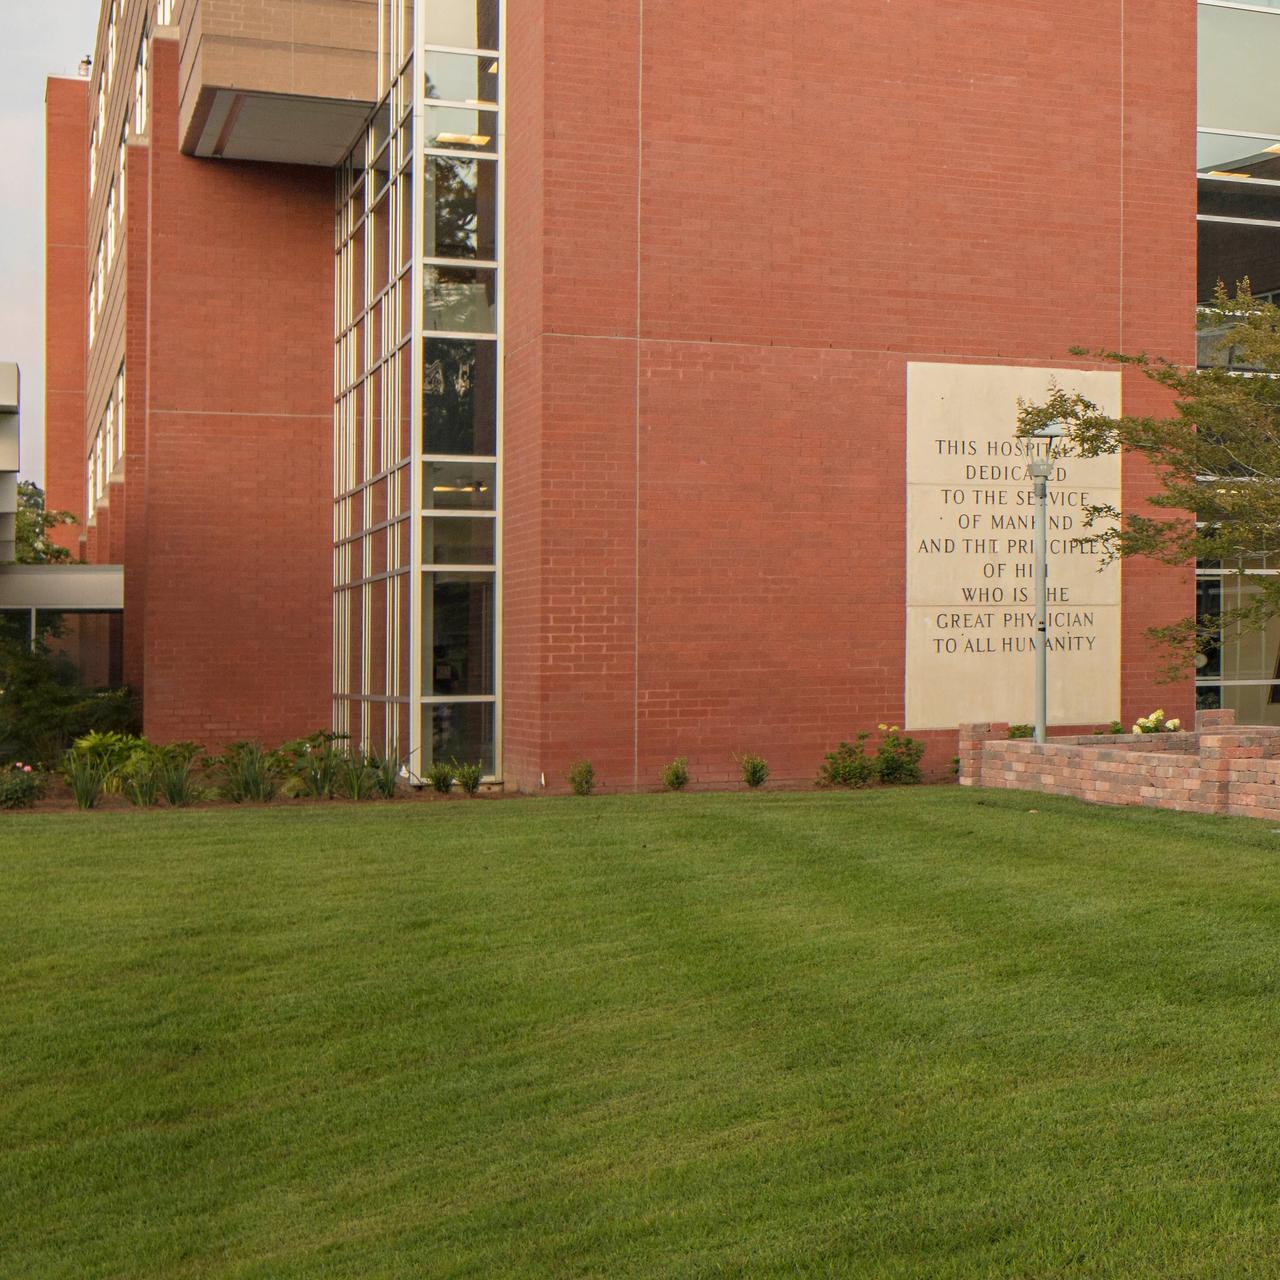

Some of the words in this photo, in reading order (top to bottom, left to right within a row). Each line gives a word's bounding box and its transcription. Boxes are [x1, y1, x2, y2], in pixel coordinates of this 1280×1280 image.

[935, 440, 977, 455] THIS
[941, 489, 965, 505] TO
[974, 490, 1008, 505] THE
[1016, 490, 1090, 507] SEVICE
[958, 514, 981, 530] OF
[991, 515, 1073, 530] MANND
[918, 538, 955, 554] AND
[1007, 538, 1112, 555] PRICIPLES
[983, 563, 1007, 579] OF
[962, 587, 1004, 603] WHO
[1013, 587, 1028, 602] IS
[1034, 587, 1070, 602] HE
[936, 613, 995, 629] GREAT
[1003, 612, 1094, 629] PHYICIAN
[933, 638, 957, 654] TO
[963, 637, 996, 653] ALL
